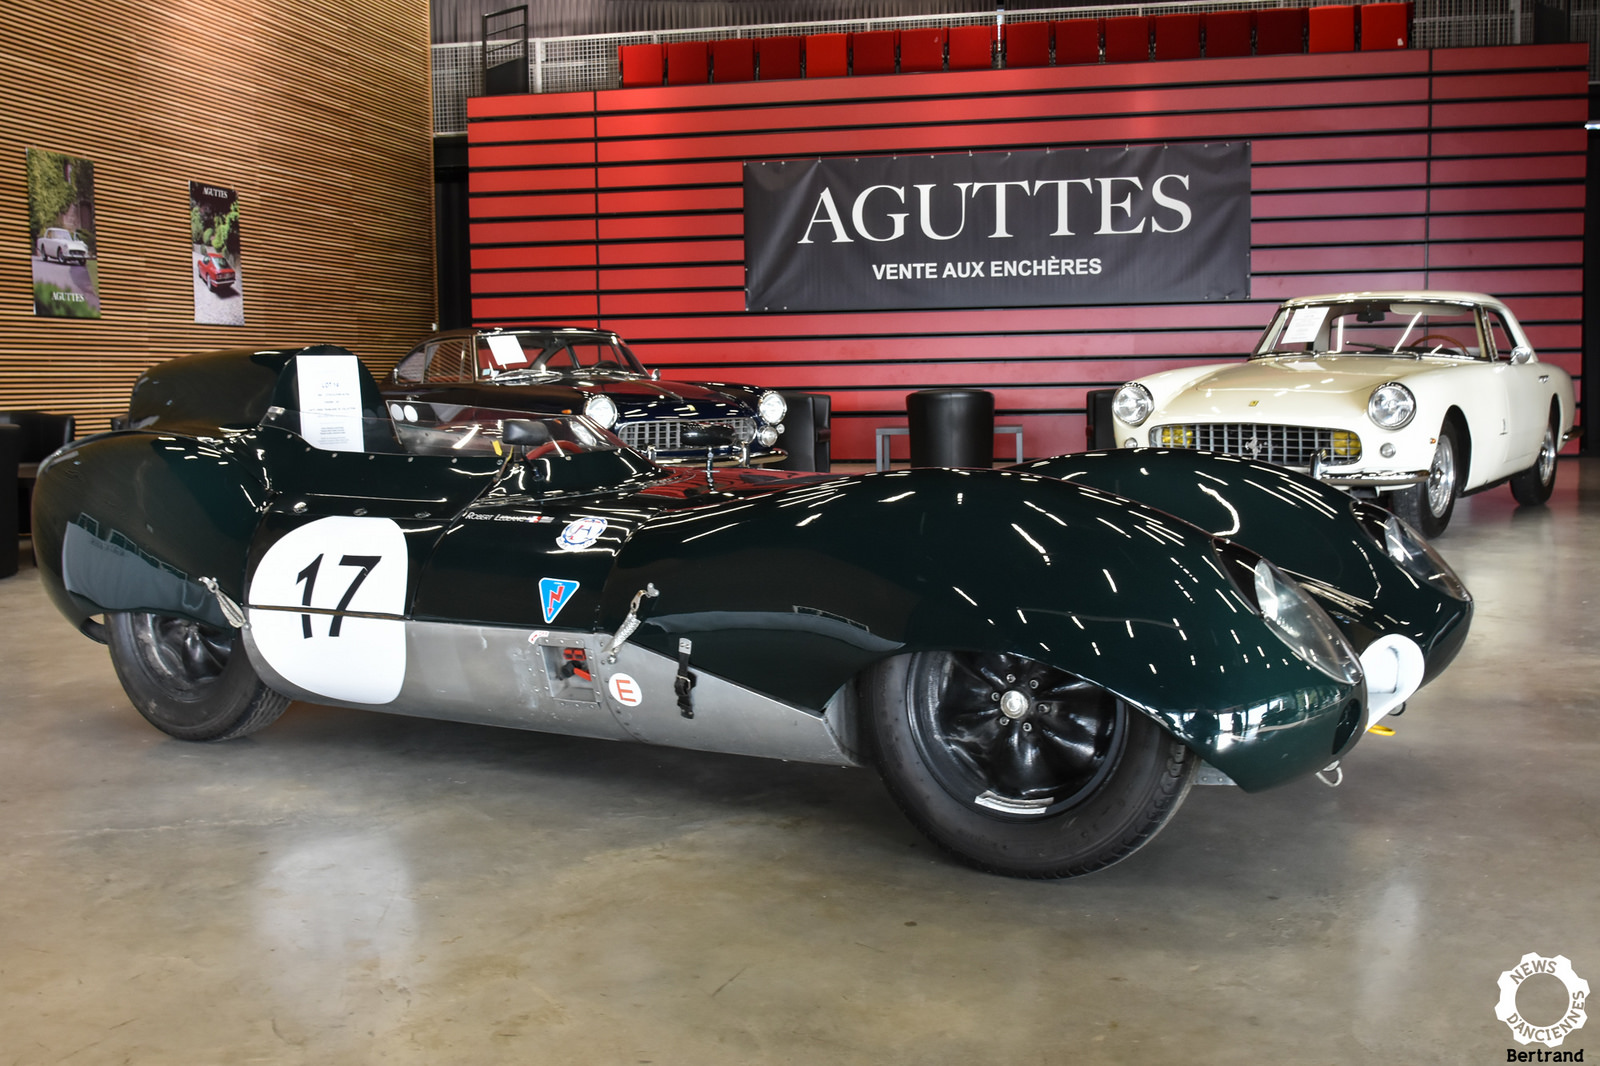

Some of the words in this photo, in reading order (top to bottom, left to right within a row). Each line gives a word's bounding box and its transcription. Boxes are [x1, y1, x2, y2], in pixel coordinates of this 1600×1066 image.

[797, 174, 1192, 244] AGUTTES
[872, 263, 938, 280] VENTE
[942, 261, 985, 278] AUX
[990, 256, 1103, 277] ENCHÈRES
[52, 291, 85, 302] AGUTTES
[296, 553, 382, 639] 17
[616, 679, 637, 703] E
